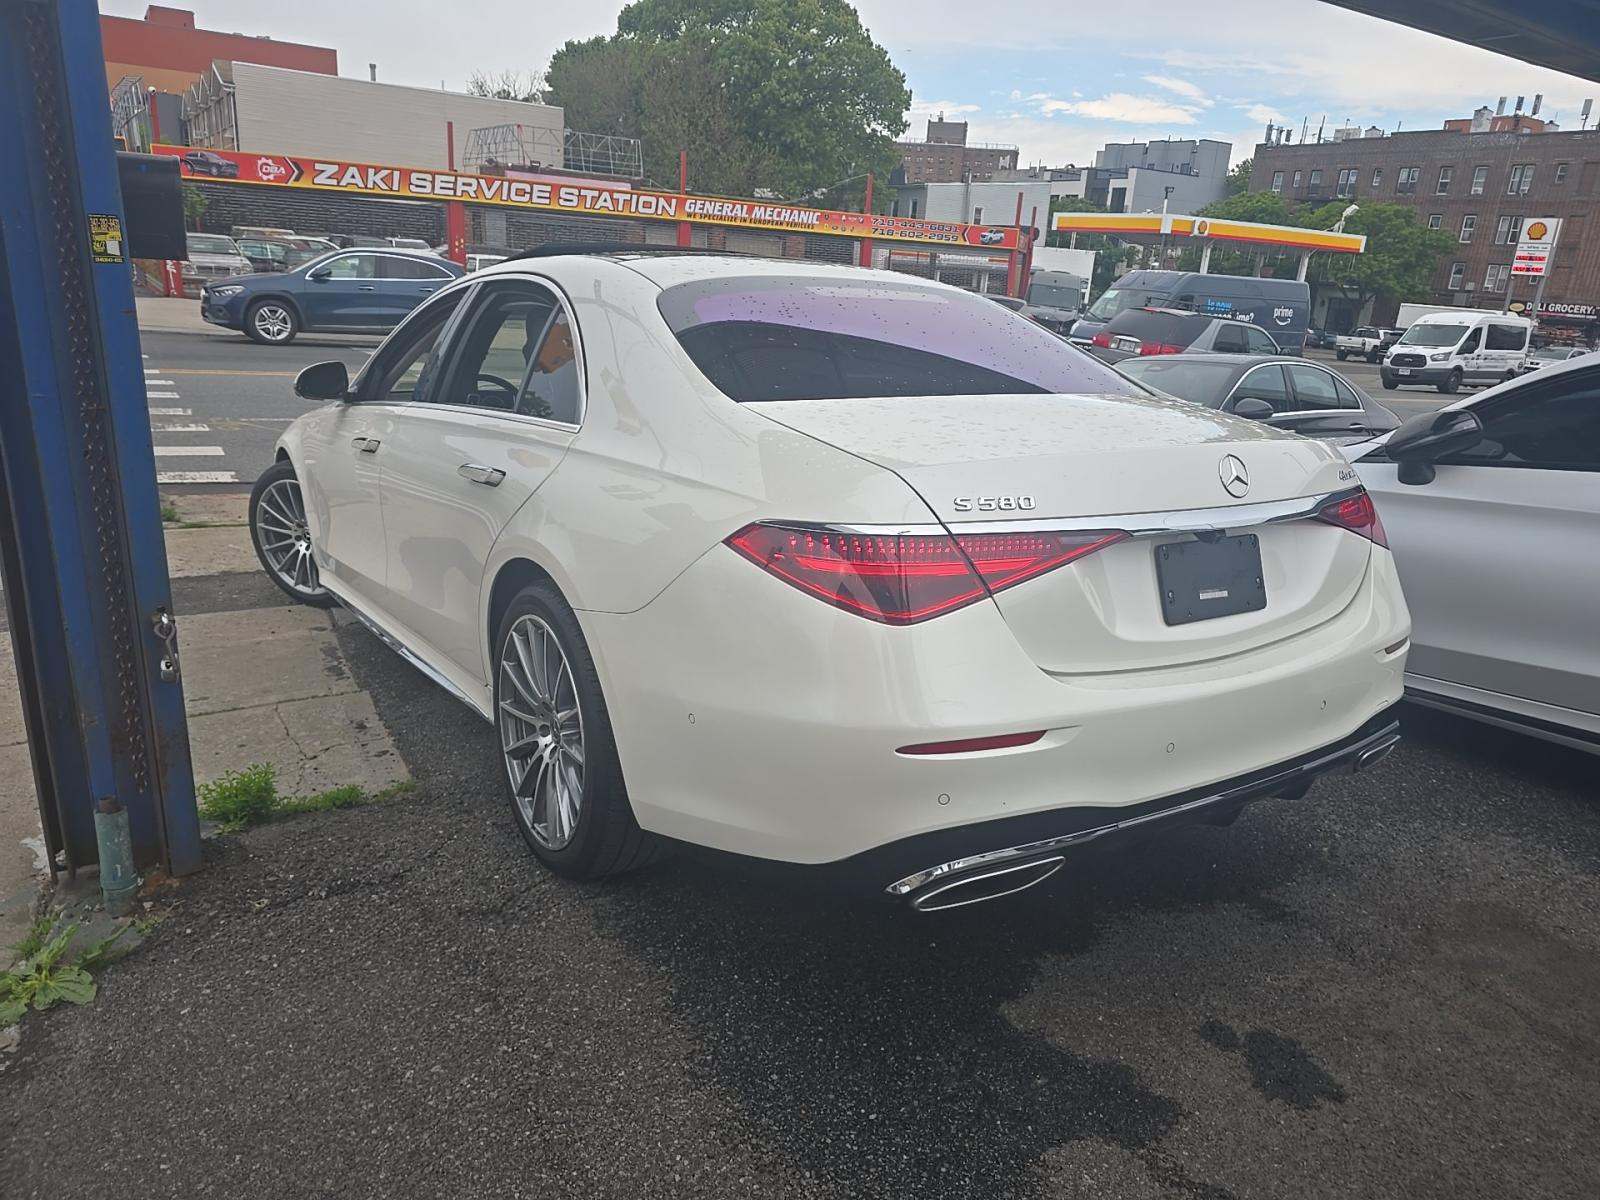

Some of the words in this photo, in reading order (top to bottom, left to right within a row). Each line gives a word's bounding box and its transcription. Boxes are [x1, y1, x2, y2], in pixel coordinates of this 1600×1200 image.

[313, 162, 400, 191] ZAKI
[409, 171, 551, 204] SERVICE
[558, 187, 676, 216] STATION
[684, 199, 749, 218] GENERAL
[751, 206, 821, 225] MECHANIC
[699, 213, 739, 224] SPECIALIZE
[1273, 306, 1294, 318] prime
[1526, 302, 1546, 311] DLI
[1548, 303, 1593, 315] GROCERY
[953, 496, 973, 512] S
[977, 496, 1036, 511] 580
